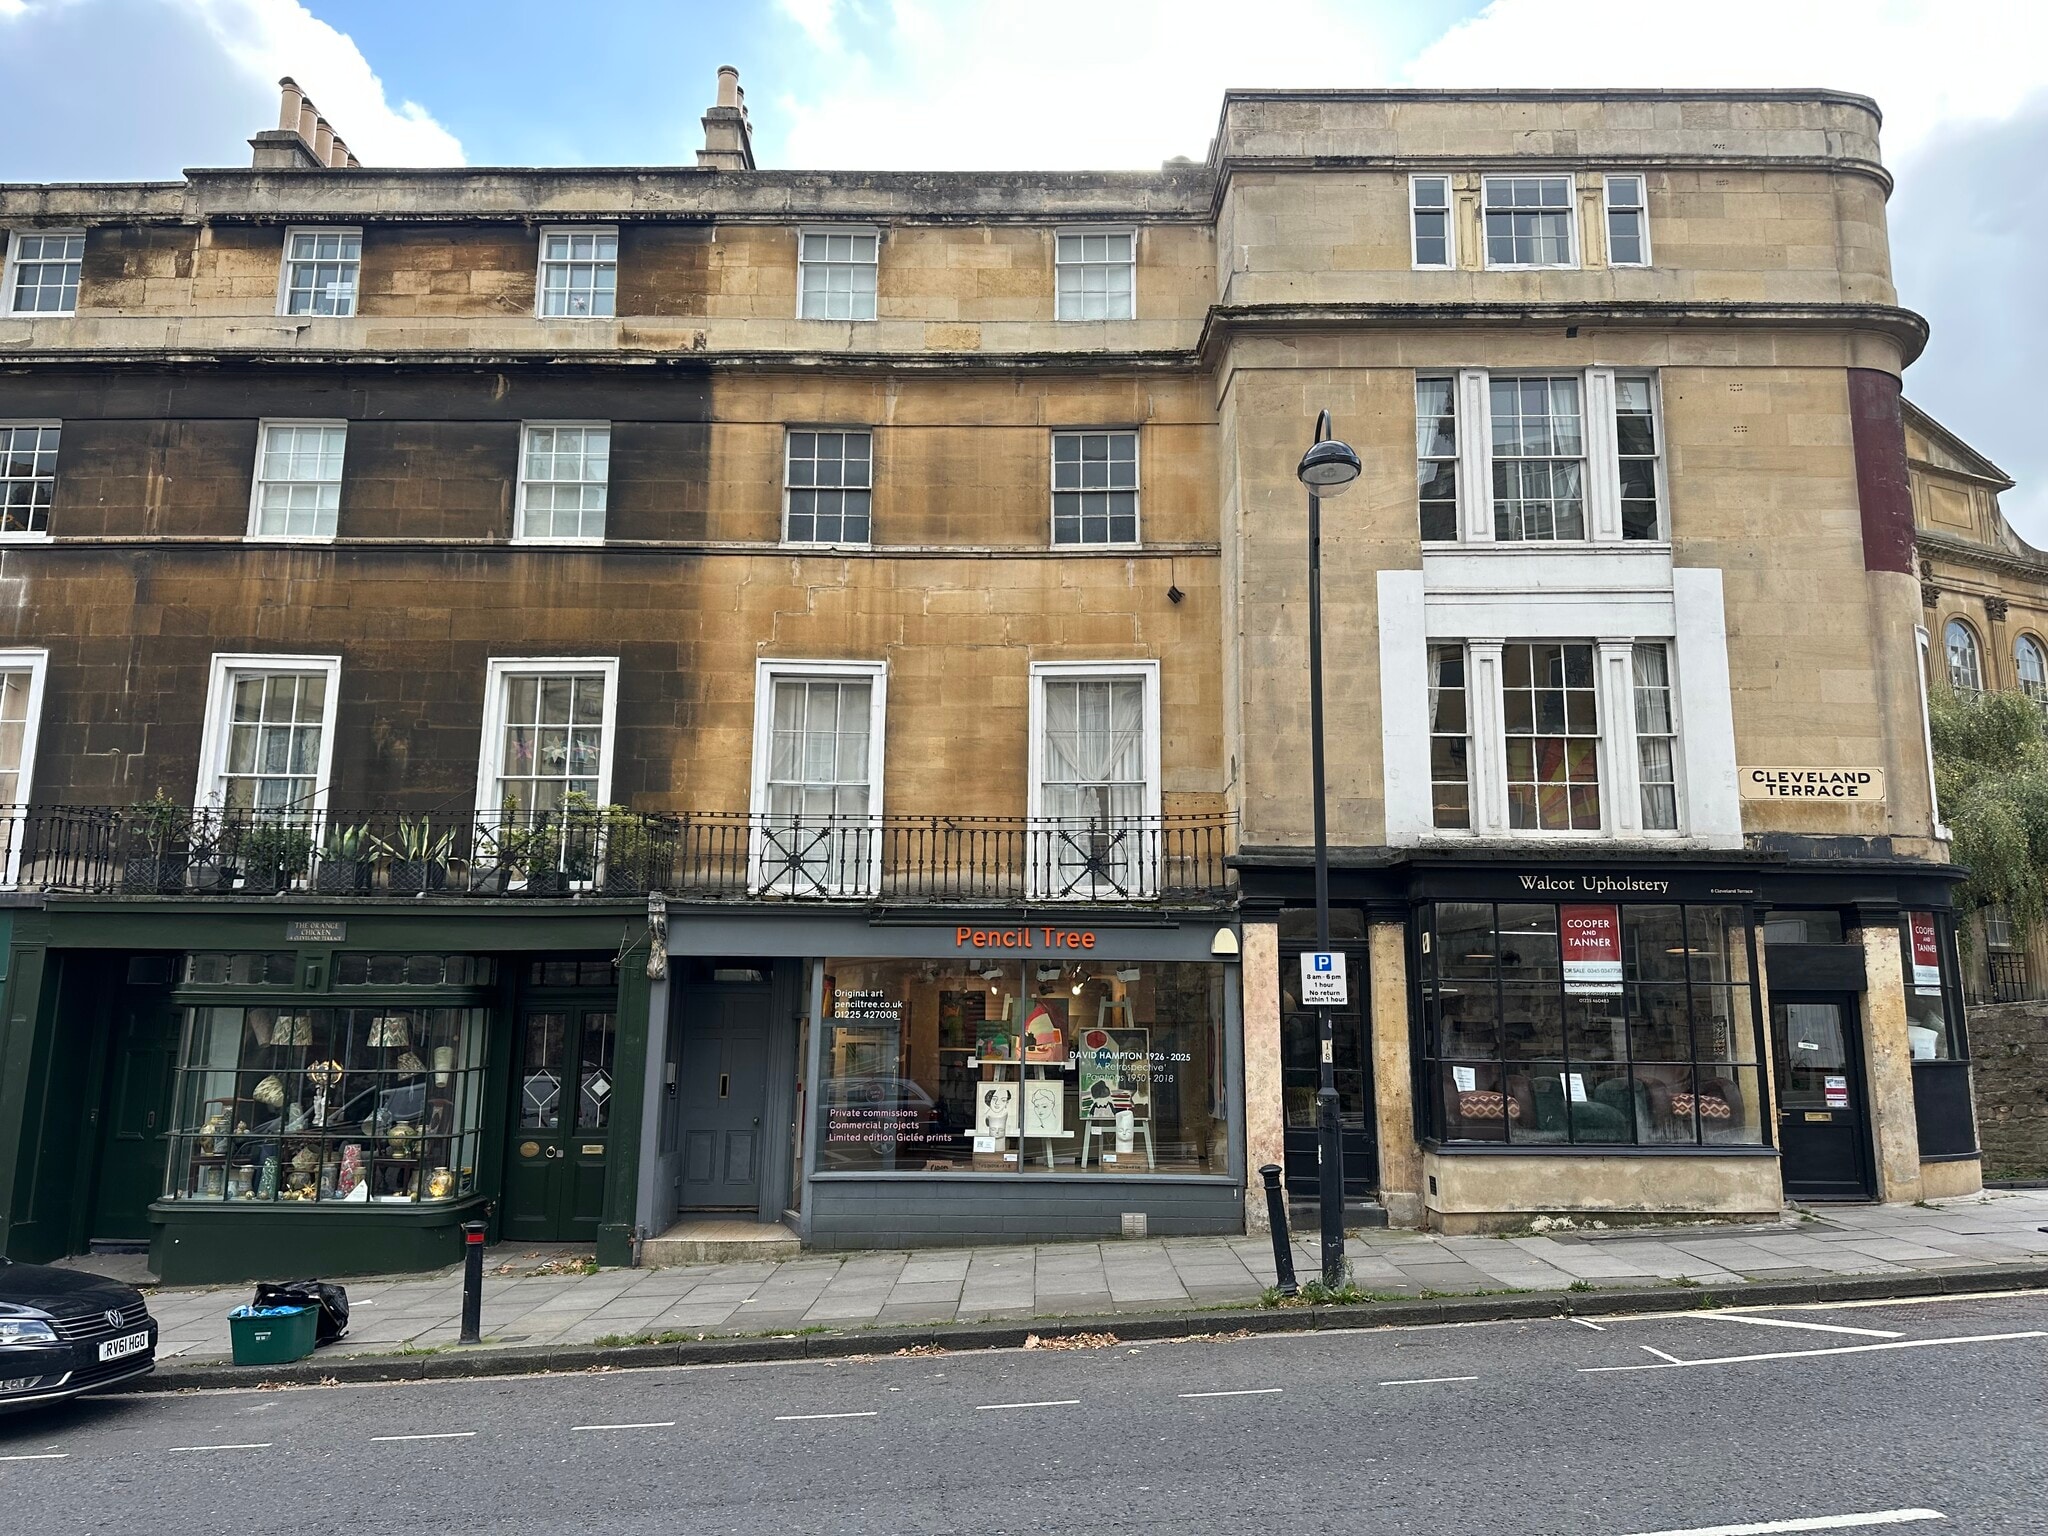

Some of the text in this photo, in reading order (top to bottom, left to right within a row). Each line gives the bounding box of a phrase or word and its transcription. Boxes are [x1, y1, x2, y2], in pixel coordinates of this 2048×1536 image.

[1752, 770, 1871, 784] CLEVELAND
[1765, 784, 1859, 797] TERRACE
[1518, 875, 1669, 894] Walcot Upholstery
[310, 922, 339, 930] ORANGE
[1567, 919, 1610, 928] COOPER
[1915, 926, 1935, 936] COOPE
[956, 926, 1096, 948] Pencil Tree
[1568, 938, 1611, 947] TANNER
[1318, 956, 1329, 970] P
[834, 989, 884, 999] Original art
[834, 1000, 903, 1010] penciltree.co.uk
[834, 1010, 898, 1019] 01225 427008
[1069, 1051, 1096, 1059] DAVID
[1099, 1051, 1143, 1060] HAMPTON
[1146, 1052, 1165, 1061] 1926
[1170, 1053, 1191, 1062] 2025
[1086, 1072, 1124, 1083] Paintings
[1127, 1074, 1146, 1082] 1950
[1154, 1074, 1174, 1083] 2018
[830, 1108, 918, 1118] Private commissions
[829, 1121, 920, 1131] Commercial projects
[828, 1132, 952, 1143] Limited edition Giclée prints
[106, 1333, 145, 1357] RV61 HGO
